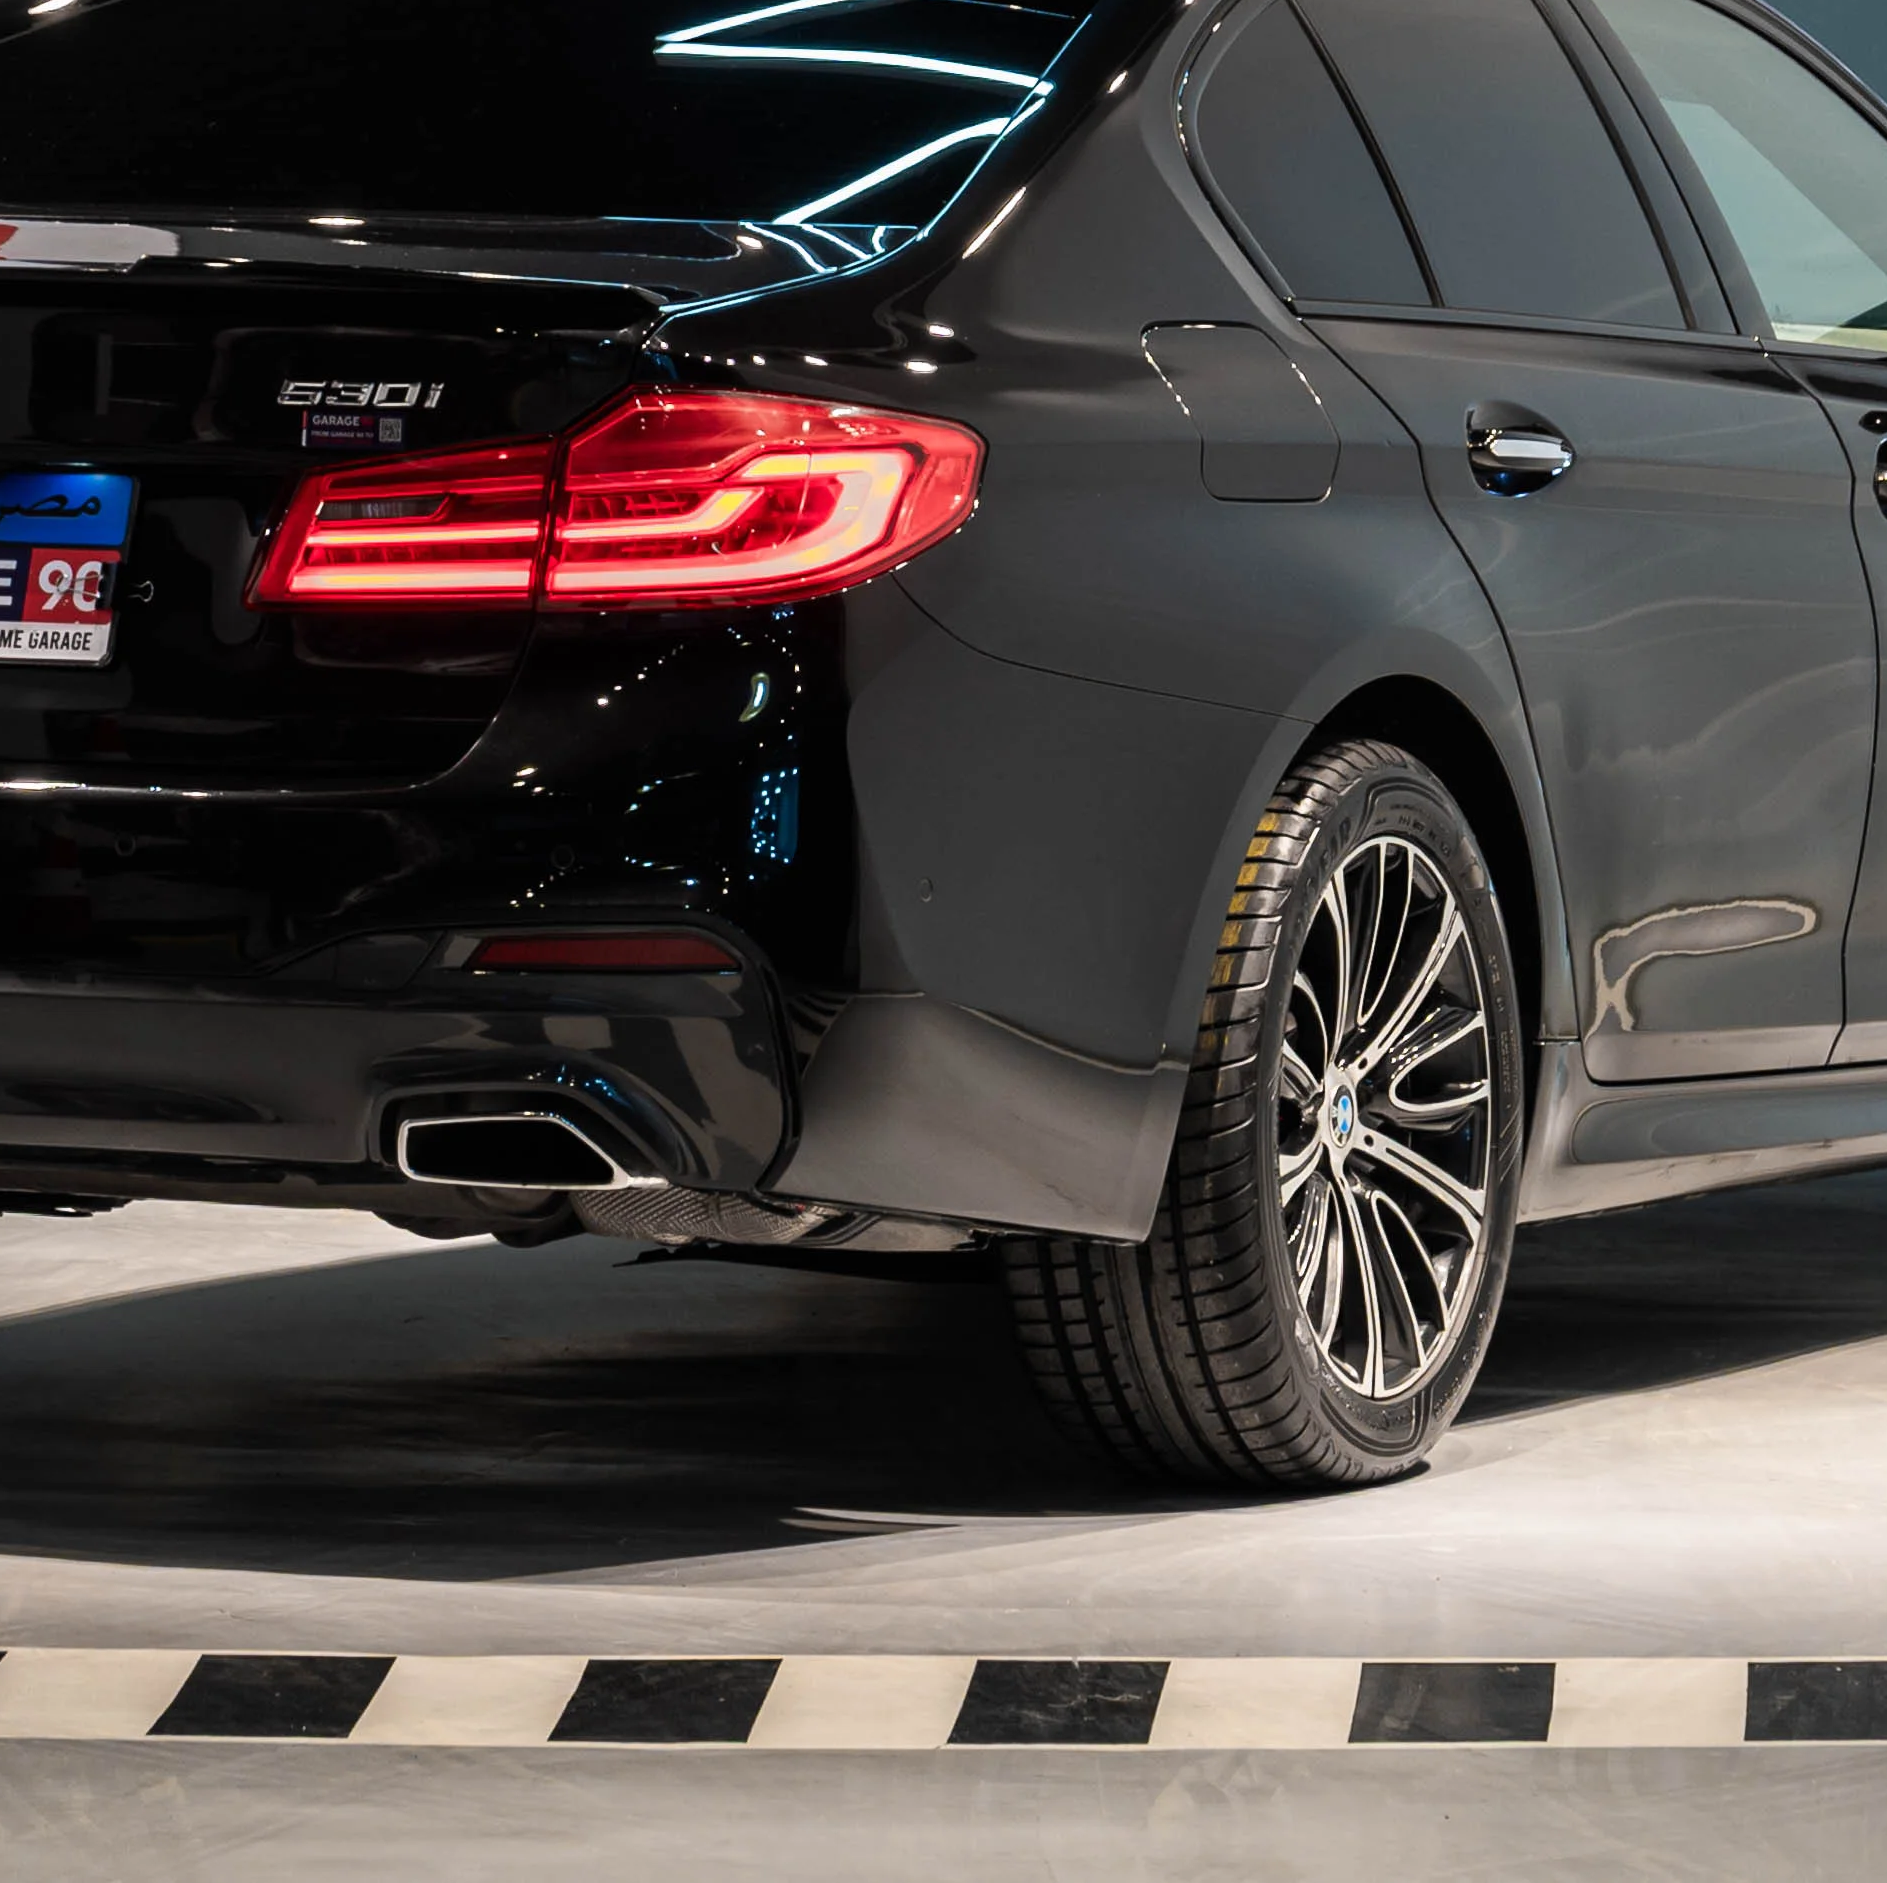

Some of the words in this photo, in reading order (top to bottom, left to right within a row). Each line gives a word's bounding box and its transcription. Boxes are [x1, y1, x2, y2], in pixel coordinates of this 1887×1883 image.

[277, 380, 445, 409] 530i
[312, 414, 361, 428] GARAGE
[37, 559, 103, 613] 90
[27, 630, 93, 653] GARAGE
